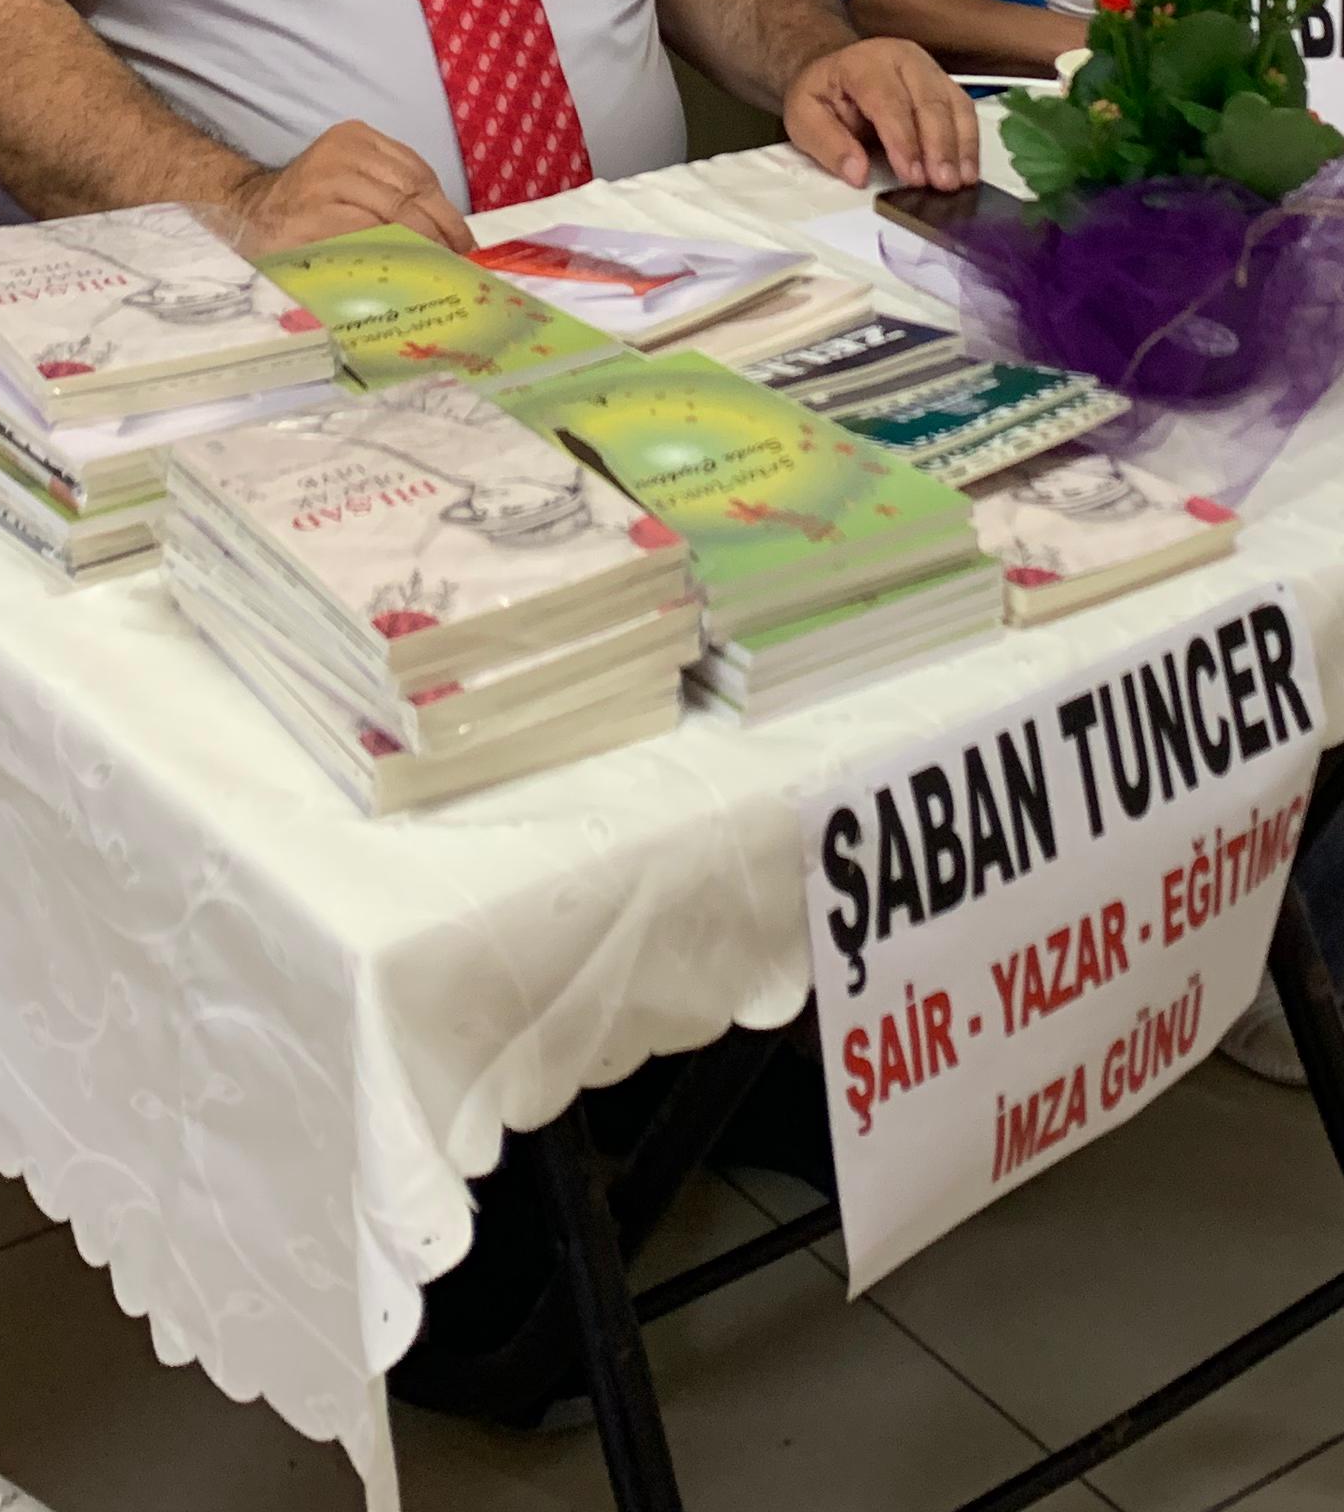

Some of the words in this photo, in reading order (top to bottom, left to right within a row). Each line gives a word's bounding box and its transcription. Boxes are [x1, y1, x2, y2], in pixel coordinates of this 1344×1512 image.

[821, 719, 1058, 997] ŞABAN
[1058, 603, 1313, 840] TUNCER
[843, 982, 959, 1136] ŞAİR
[968, 1013, 982, 1038] -
[991, 899, 1132, 1038] YAZAR
[1163, 796, 1303, 948] EĞİTİMC
[992, 1062, 1087, 1184] İMZA
[1100, 972, 1204, 1112] GÜNÜ
